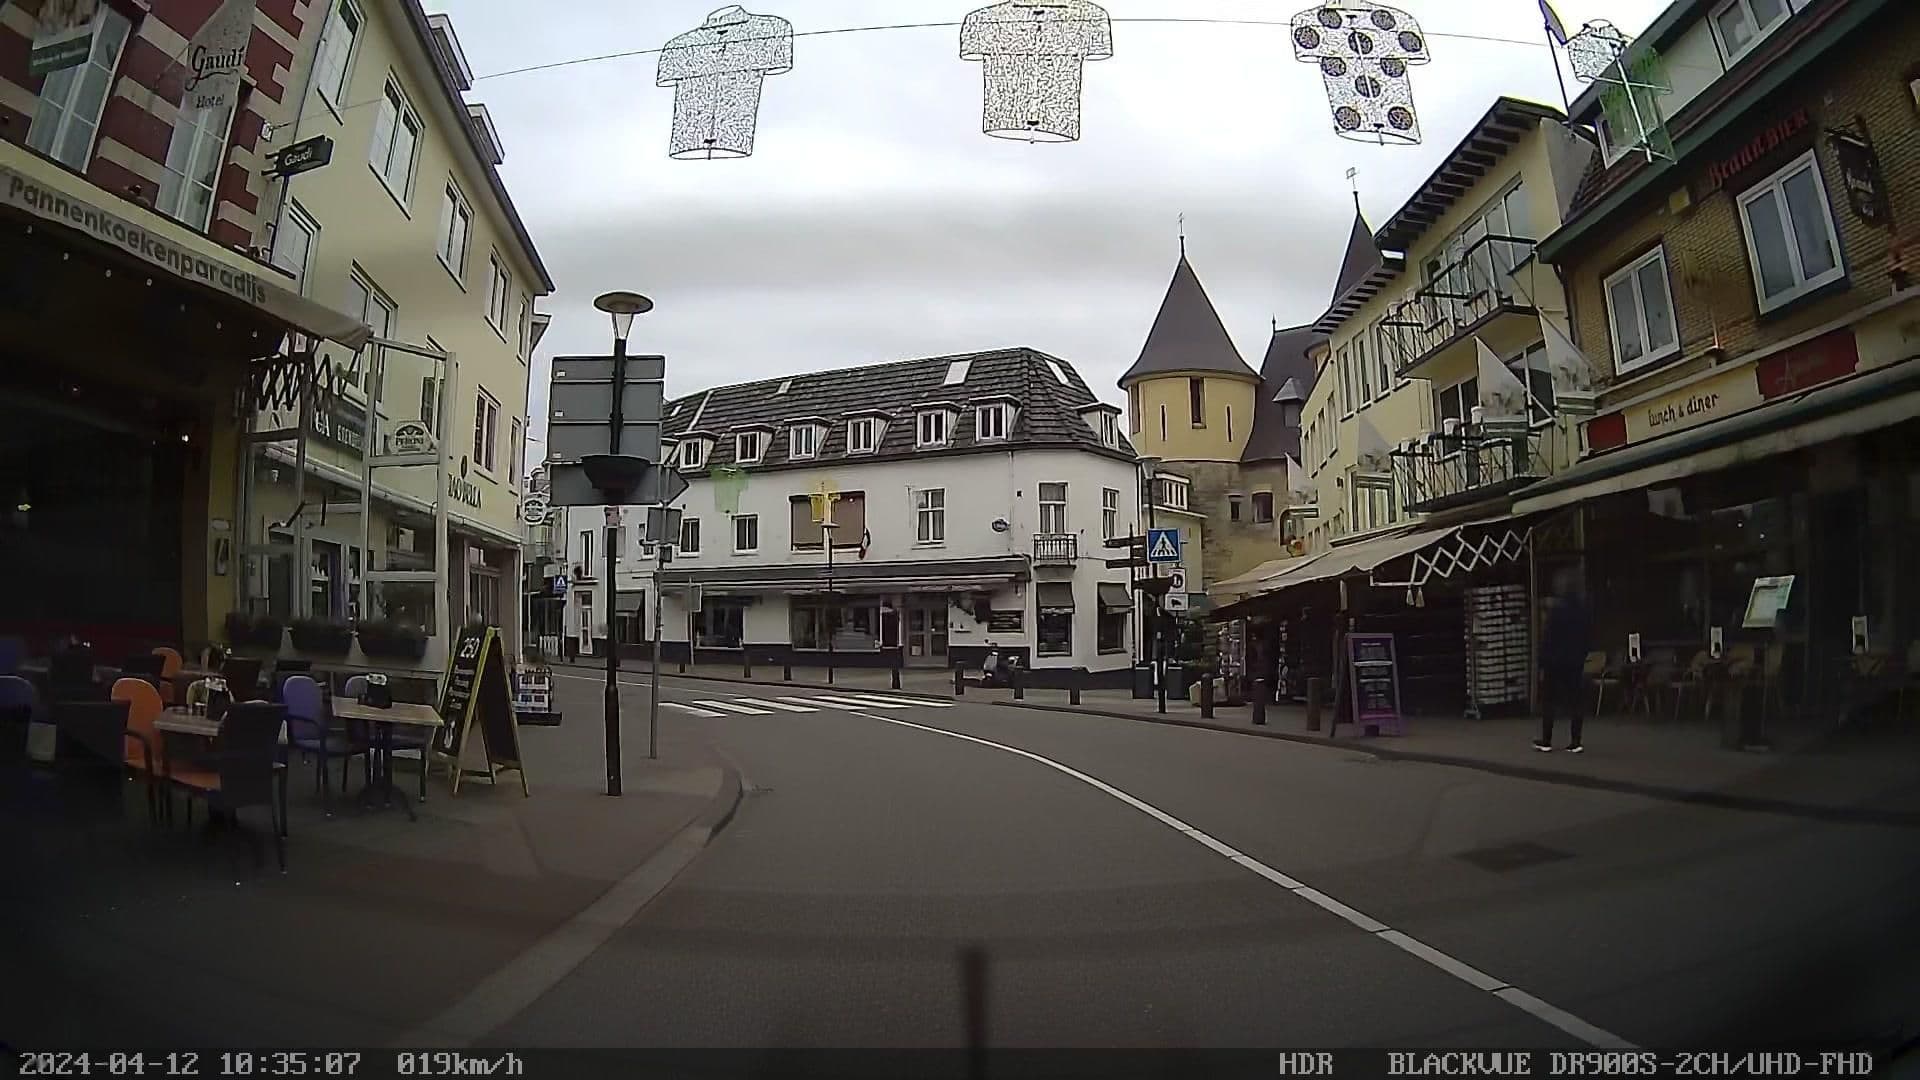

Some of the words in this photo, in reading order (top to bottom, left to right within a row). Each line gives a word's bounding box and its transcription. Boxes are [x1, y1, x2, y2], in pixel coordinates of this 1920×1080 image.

[196, 94, 225, 108] Hotel
[1648, 404, 1676, 427] lunch
[1687, 393, 1719, 415] diner
